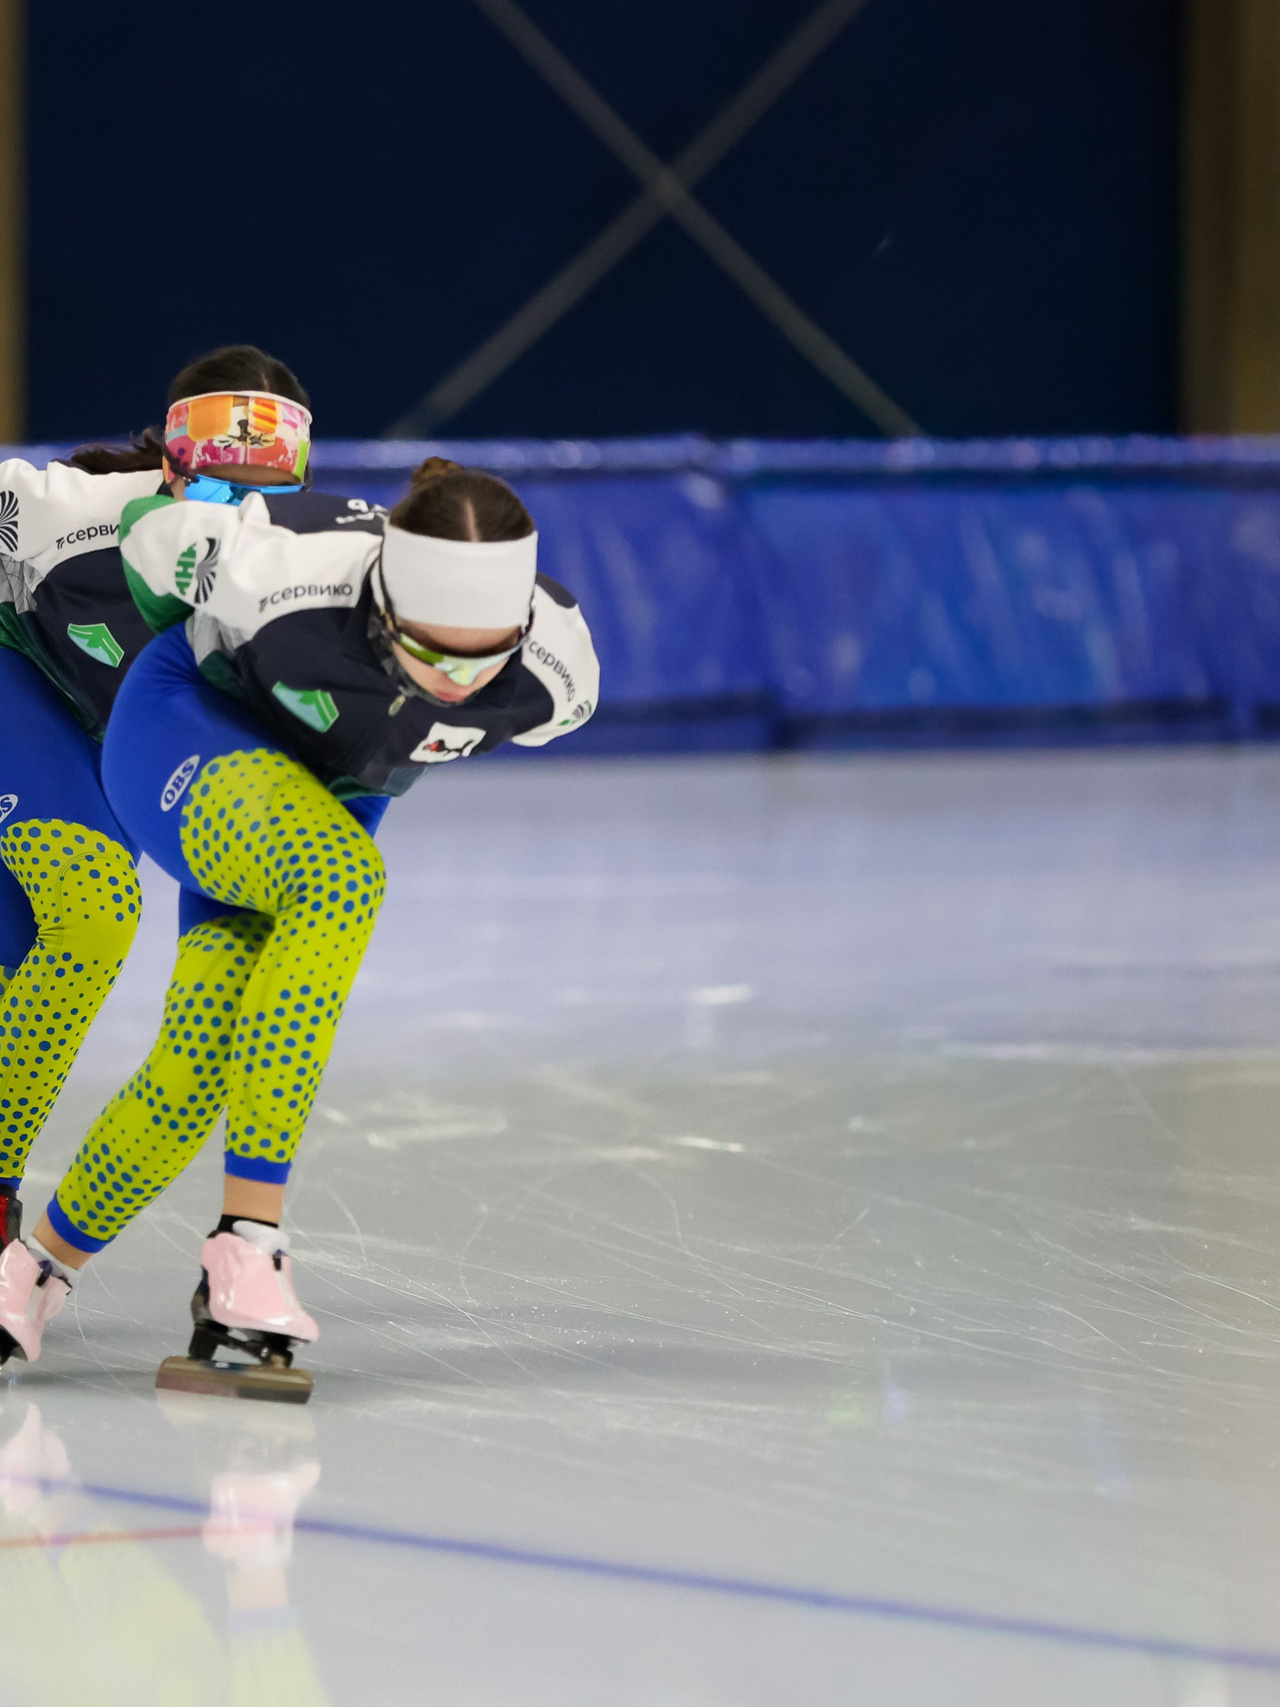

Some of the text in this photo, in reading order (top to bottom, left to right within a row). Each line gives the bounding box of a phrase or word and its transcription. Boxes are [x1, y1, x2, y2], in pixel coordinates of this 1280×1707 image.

[66, 523, 120, 545] серви
[270, 583, 354, 605] сервико
[528, 640, 576, 703] сервико
[164, 761, 195, 806] OBS
